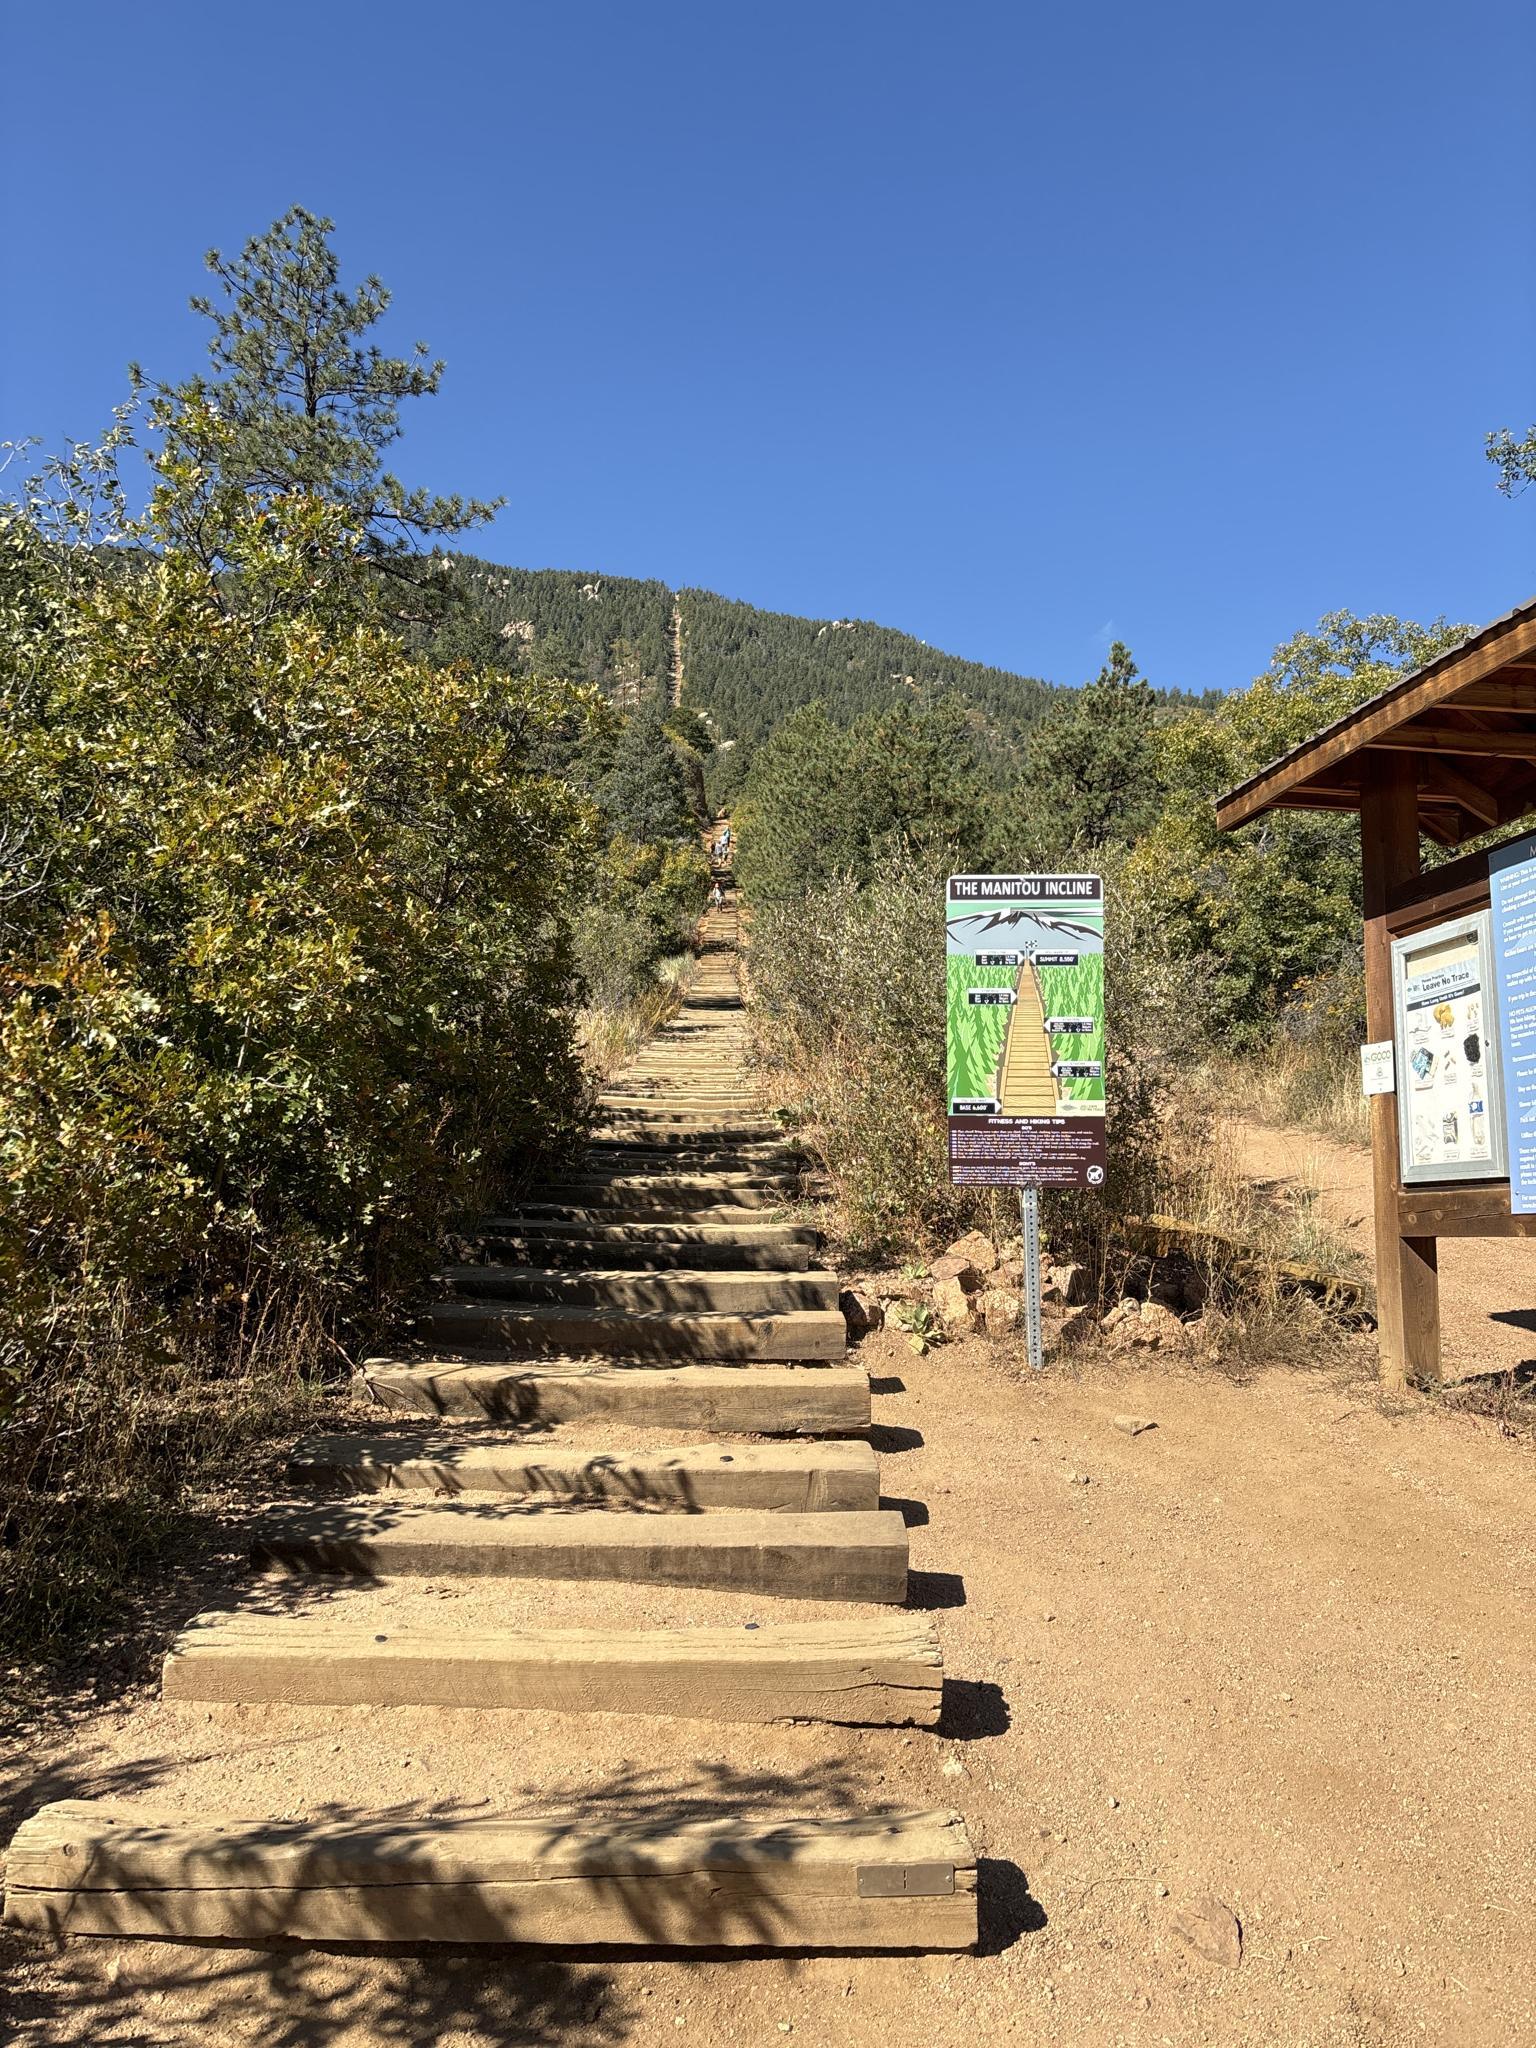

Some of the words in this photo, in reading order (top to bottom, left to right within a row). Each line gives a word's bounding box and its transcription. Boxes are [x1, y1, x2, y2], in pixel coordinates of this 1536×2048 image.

[955, 882, 977, 896] THE
[981, 882, 1040, 896] MANITOU
[1046, 882, 1092, 895] INCLINE
[1422, 981, 1440, 991] Leave
[1442, 977, 1450, 986] No
[1452, 972, 1470, 982] Trace
